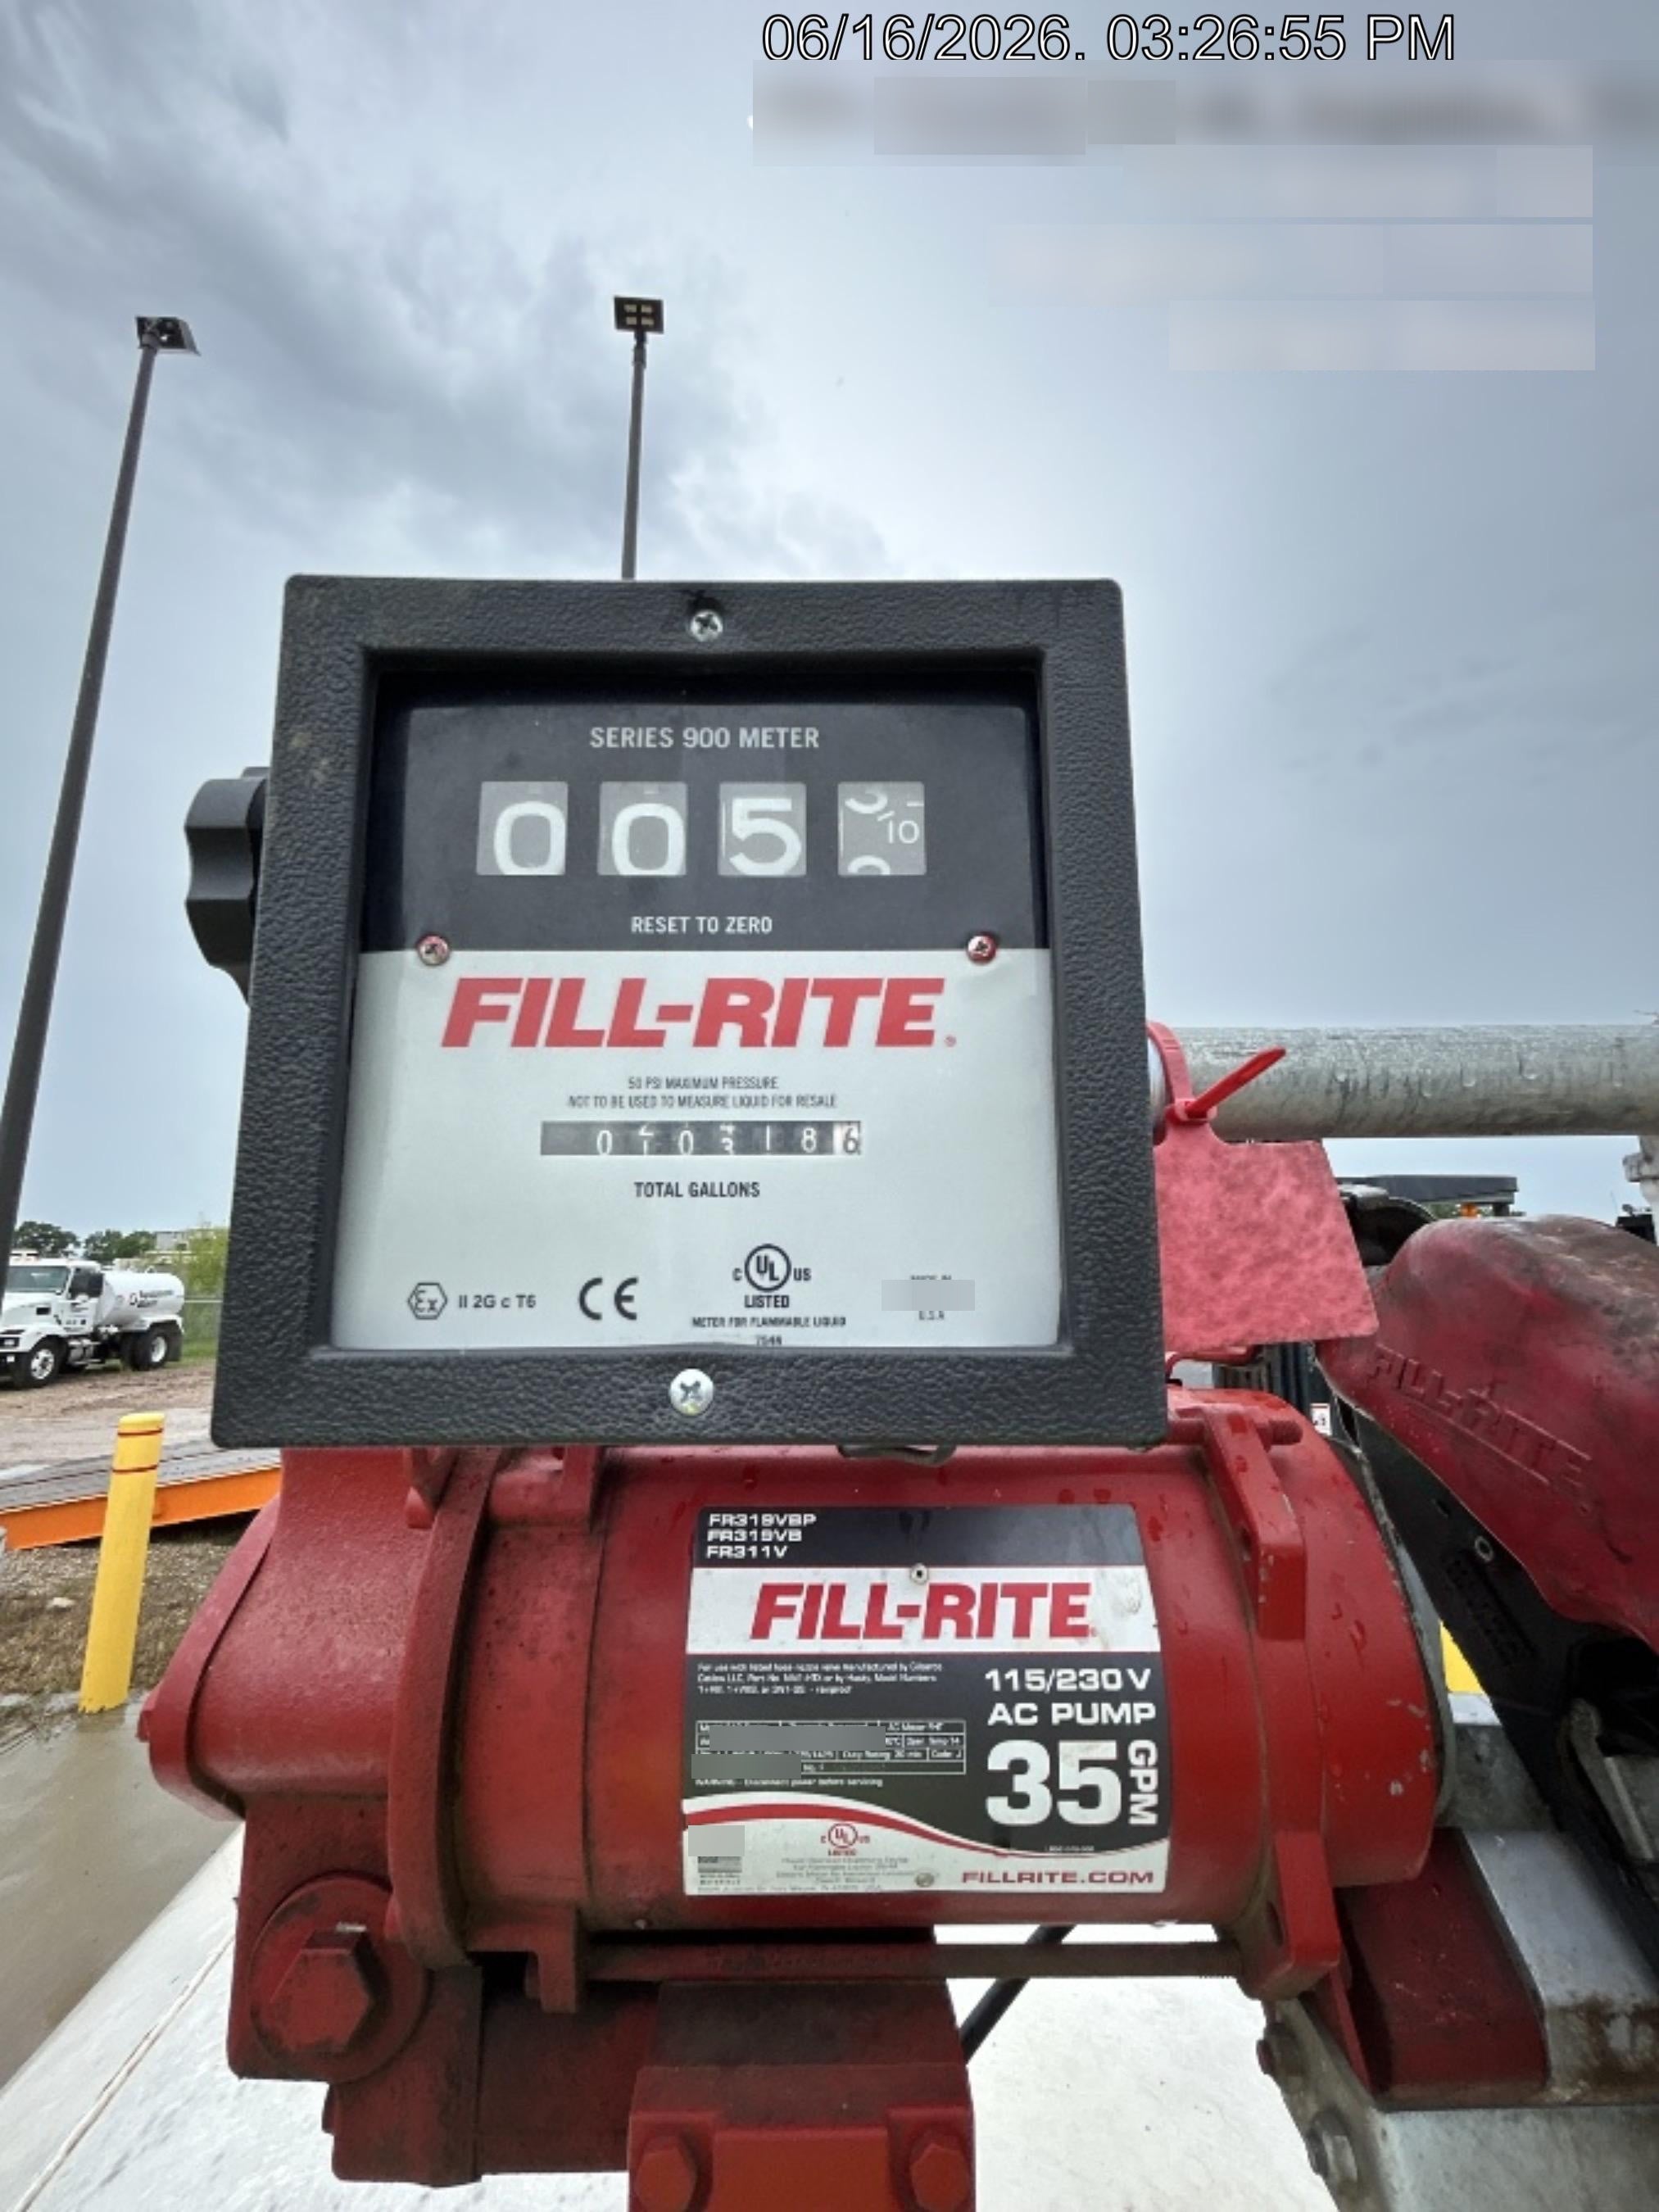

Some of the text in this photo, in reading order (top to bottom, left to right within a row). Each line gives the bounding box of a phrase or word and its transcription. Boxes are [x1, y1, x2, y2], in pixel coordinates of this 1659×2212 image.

[589, 727, 819, 749] SERIES 900 METER
[631, 915, 773, 935] RESET TO ZERO
[665, 1076, 718, 1090] MAXIMUM
[722, 1076, 778, 1090] PRESSURE
[628, 1095, 655, 1108] USED
[678, 1095, 729, 1108] MEASURE
[796, 1095, 836, 1108] RESALE
[634, 1181, 760, 1199] TOTAL GALLONS
[473, 1294, 496, 1308] 2G
[516, 1294, 537, 1308] T6
[578, 1277, 639, 1321] CE
[744, 1294, 791, 1308] LISTED
[692, 1317, 726, 1328] METER
[750, 1583, 1092, 1639] FILL-RITE
[985, 1668, 1151, 1693] 115/230 V
[987, 1702, 1156, 1725] AC PUMP
[986, 1739, 1158, 1825] 35 GPM
[962, 1871, 1154, 1884] FILLRITE.COM
